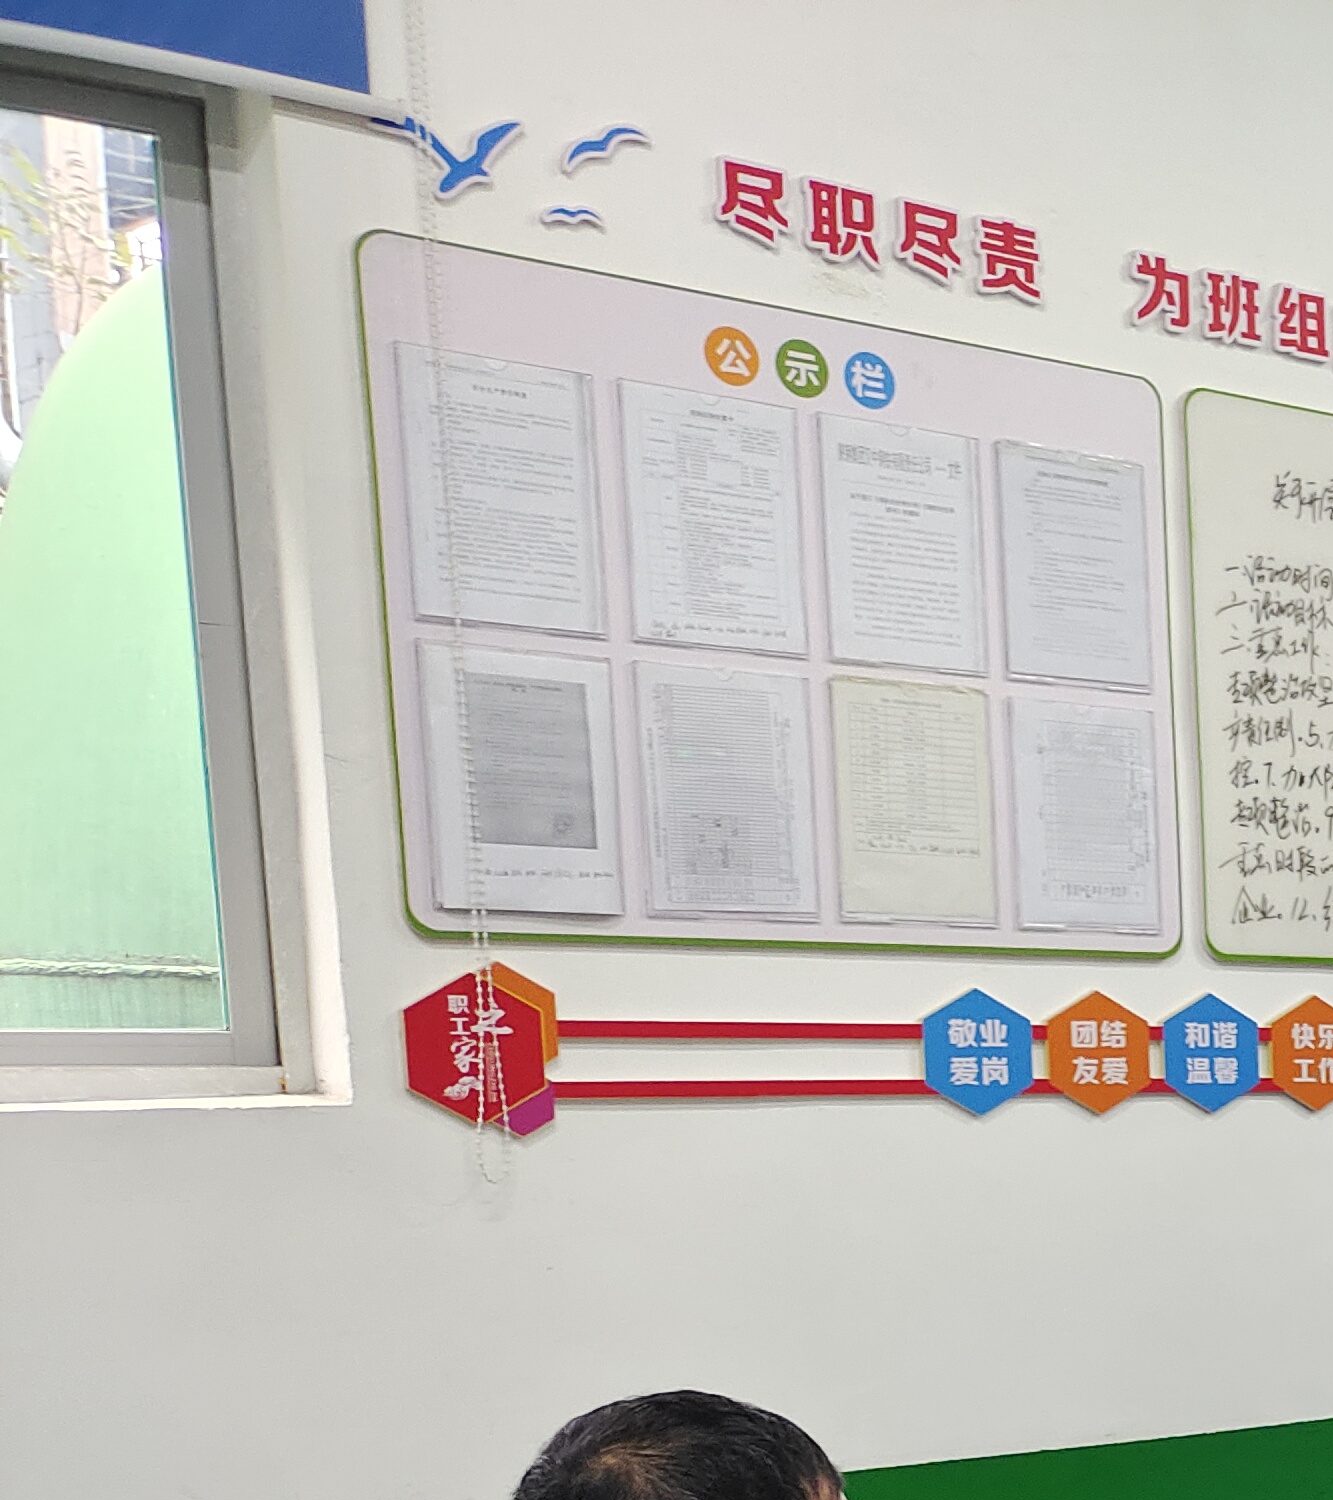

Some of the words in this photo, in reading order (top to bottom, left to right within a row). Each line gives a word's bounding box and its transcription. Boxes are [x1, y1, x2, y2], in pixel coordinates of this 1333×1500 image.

[719, 158, 1043, 302] 尽职尽责
[712, 333, 890, 407] 公示栏
[947, 1018, 1008, 1051] 敬业
[1070, 1020, 1128, 1051] 团结
[1184, 1021, 1238, 1050] 和谐
[949, 1056, 1009, 1087] 爱岗
[1071, 1057, 1129, 1086] 友爱
[1185, 1057, 1240, 1085] 温馨
